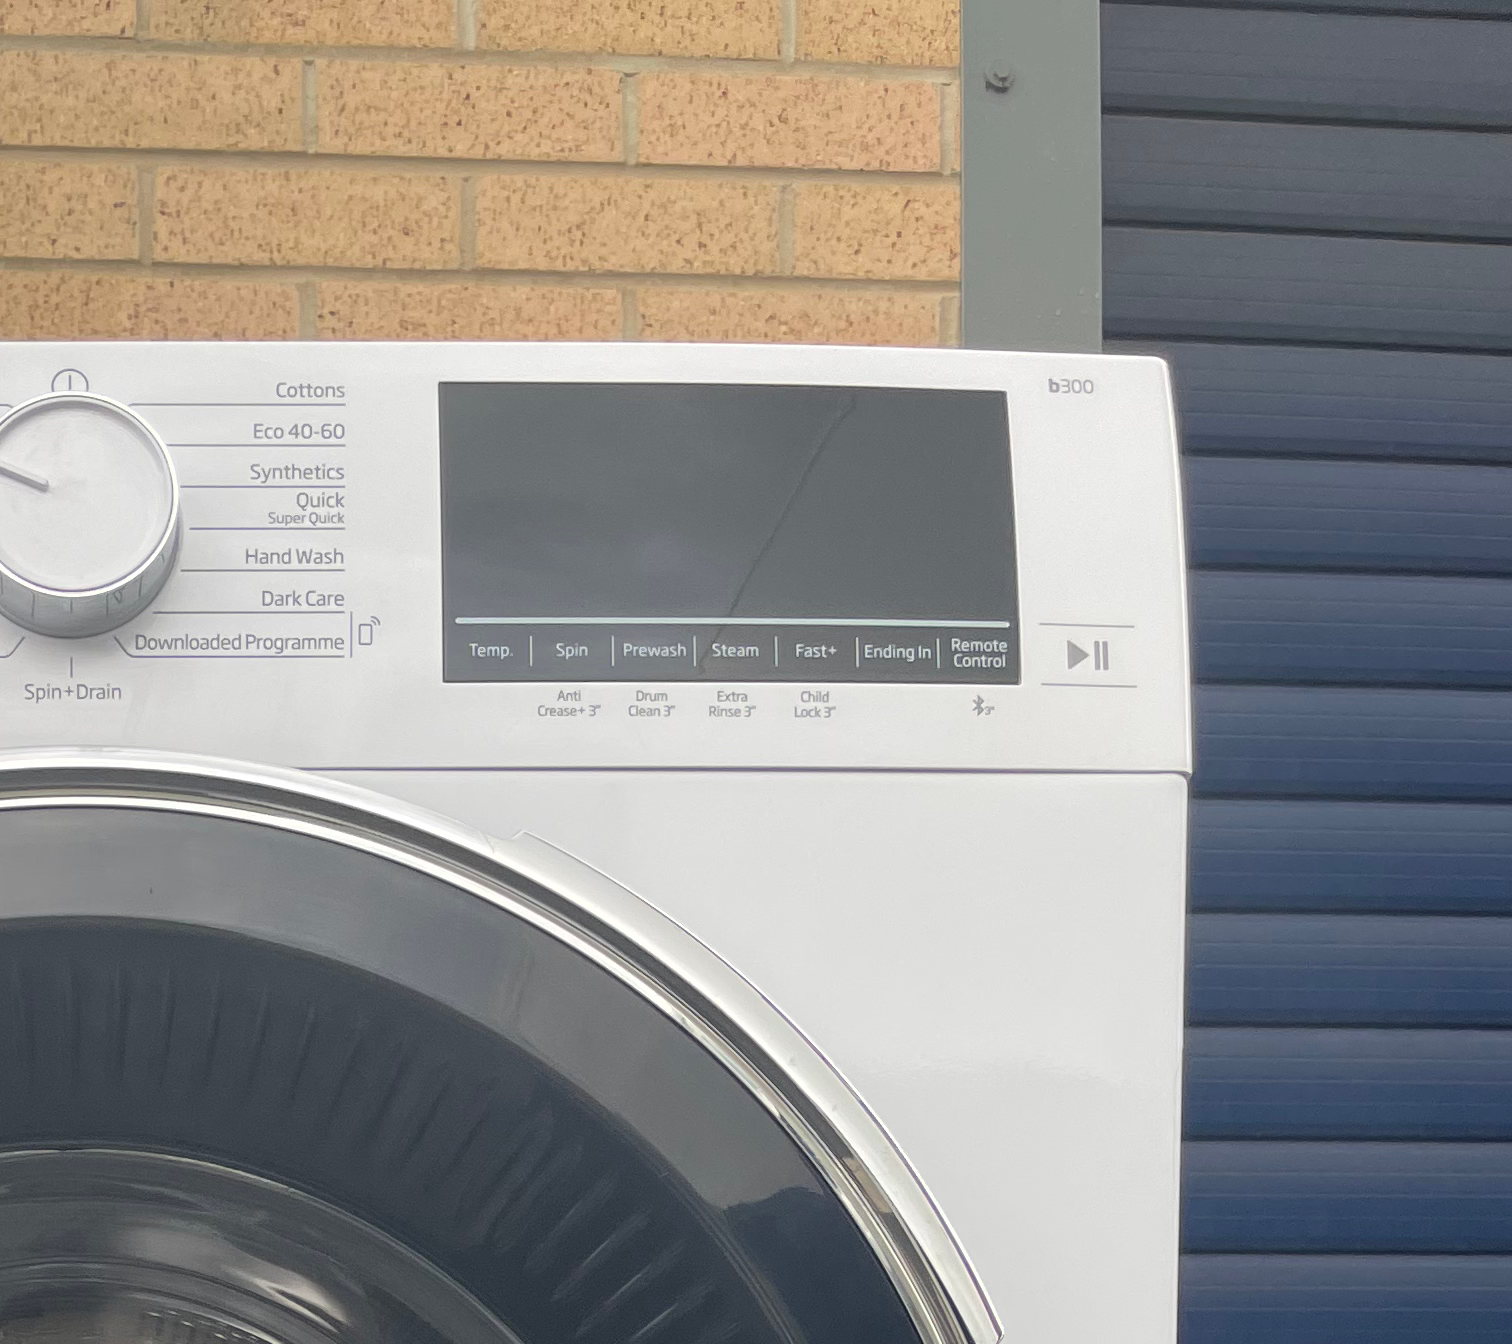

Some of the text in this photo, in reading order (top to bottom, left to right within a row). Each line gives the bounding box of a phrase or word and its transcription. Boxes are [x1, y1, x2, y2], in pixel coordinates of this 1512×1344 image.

[276, 382, 345, 398] Cottons
[1048, 378, 1094, 394] b300
[254, 424, 345, 439] Eco 40-60
[250, 464, 345, 484] Synthetics
[296, 492, 345, 511] Quick
[268, 512, 344, 526] Super Quick
[246, 548, 344, 564] Hand Wash
[262, 590, 344, 606] Dark Care
[135, 634, 344, 654] Downloaded Programme
[469, 643, 513, 659] Temp.
[556, 643, 588, 659] Spin
[624, 643, 686, 658] Prewash
[712, 643, 759, 657] Steam
[796, 644, 837, 658] Fast+
[952, 638, 1007, 653] Remote
[865, 645, 931, 662] Ending In
[954, 654, 1005, 669] Control
[25, 683, 121, 703] Spin+Drain
[557, 690, 581, 701] Anti
[636, 690, 668, 702] Drum
[717, 691, 748, 702] Extra
[801, 691, 829, 703] Child
[538, 705, 585, 716] Crease+
[629, 705, 660, 717] Clean
[709, 706, 740, 717] Rinse
[794, 706, 821, 718] Lock
